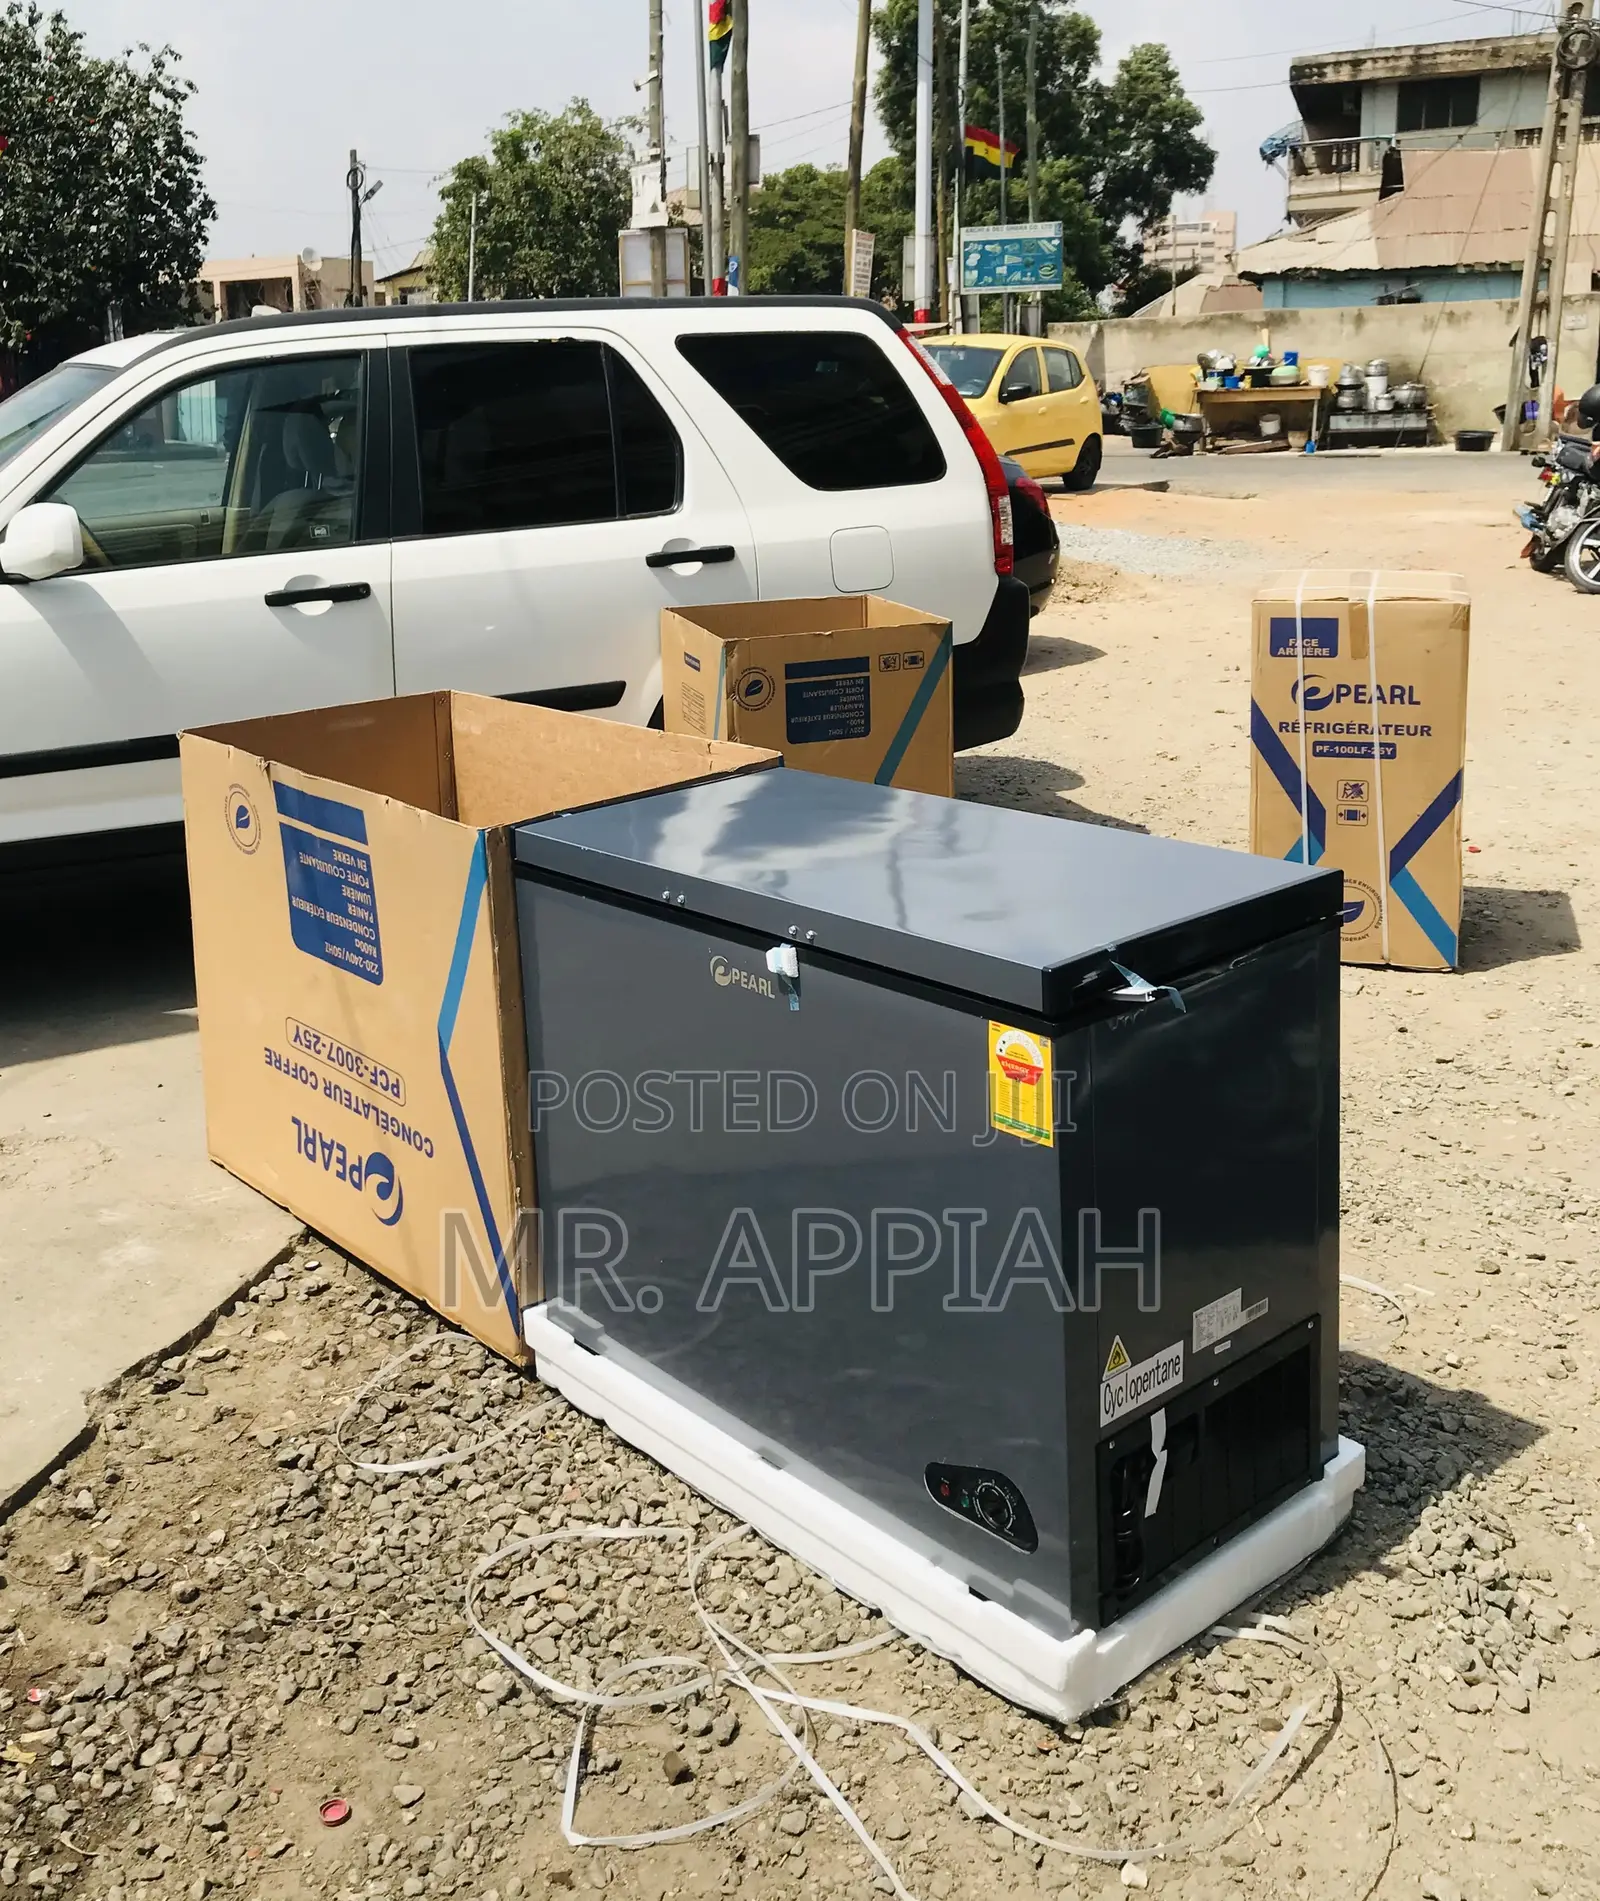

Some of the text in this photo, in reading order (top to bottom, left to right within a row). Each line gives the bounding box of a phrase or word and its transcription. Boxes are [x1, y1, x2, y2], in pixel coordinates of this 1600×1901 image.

[1288, 638, 1319, 647] FCE
[1336, 684, 1421, 705] PEARL
[298, 852, 370, 889] PORTE COULISSANTE
[333, 849, 367, 872] EN VERRE
[341, 884, 372, 906] LUMIÈRE
[325, 911, 376, 940] CONDENSEUR
[347, 902, 374, 924] PANIER
[731, 967, 775, 999] PEARL
[293, 1025, 401, 1099] PCF-3007-25Y
[264, 1046, 434, 1158] CONGÉLATEUR COFFRE
[291, 1115, 363, 1192] PEARL
[1104, 1355, 1181, 1418] Cyclopentane
